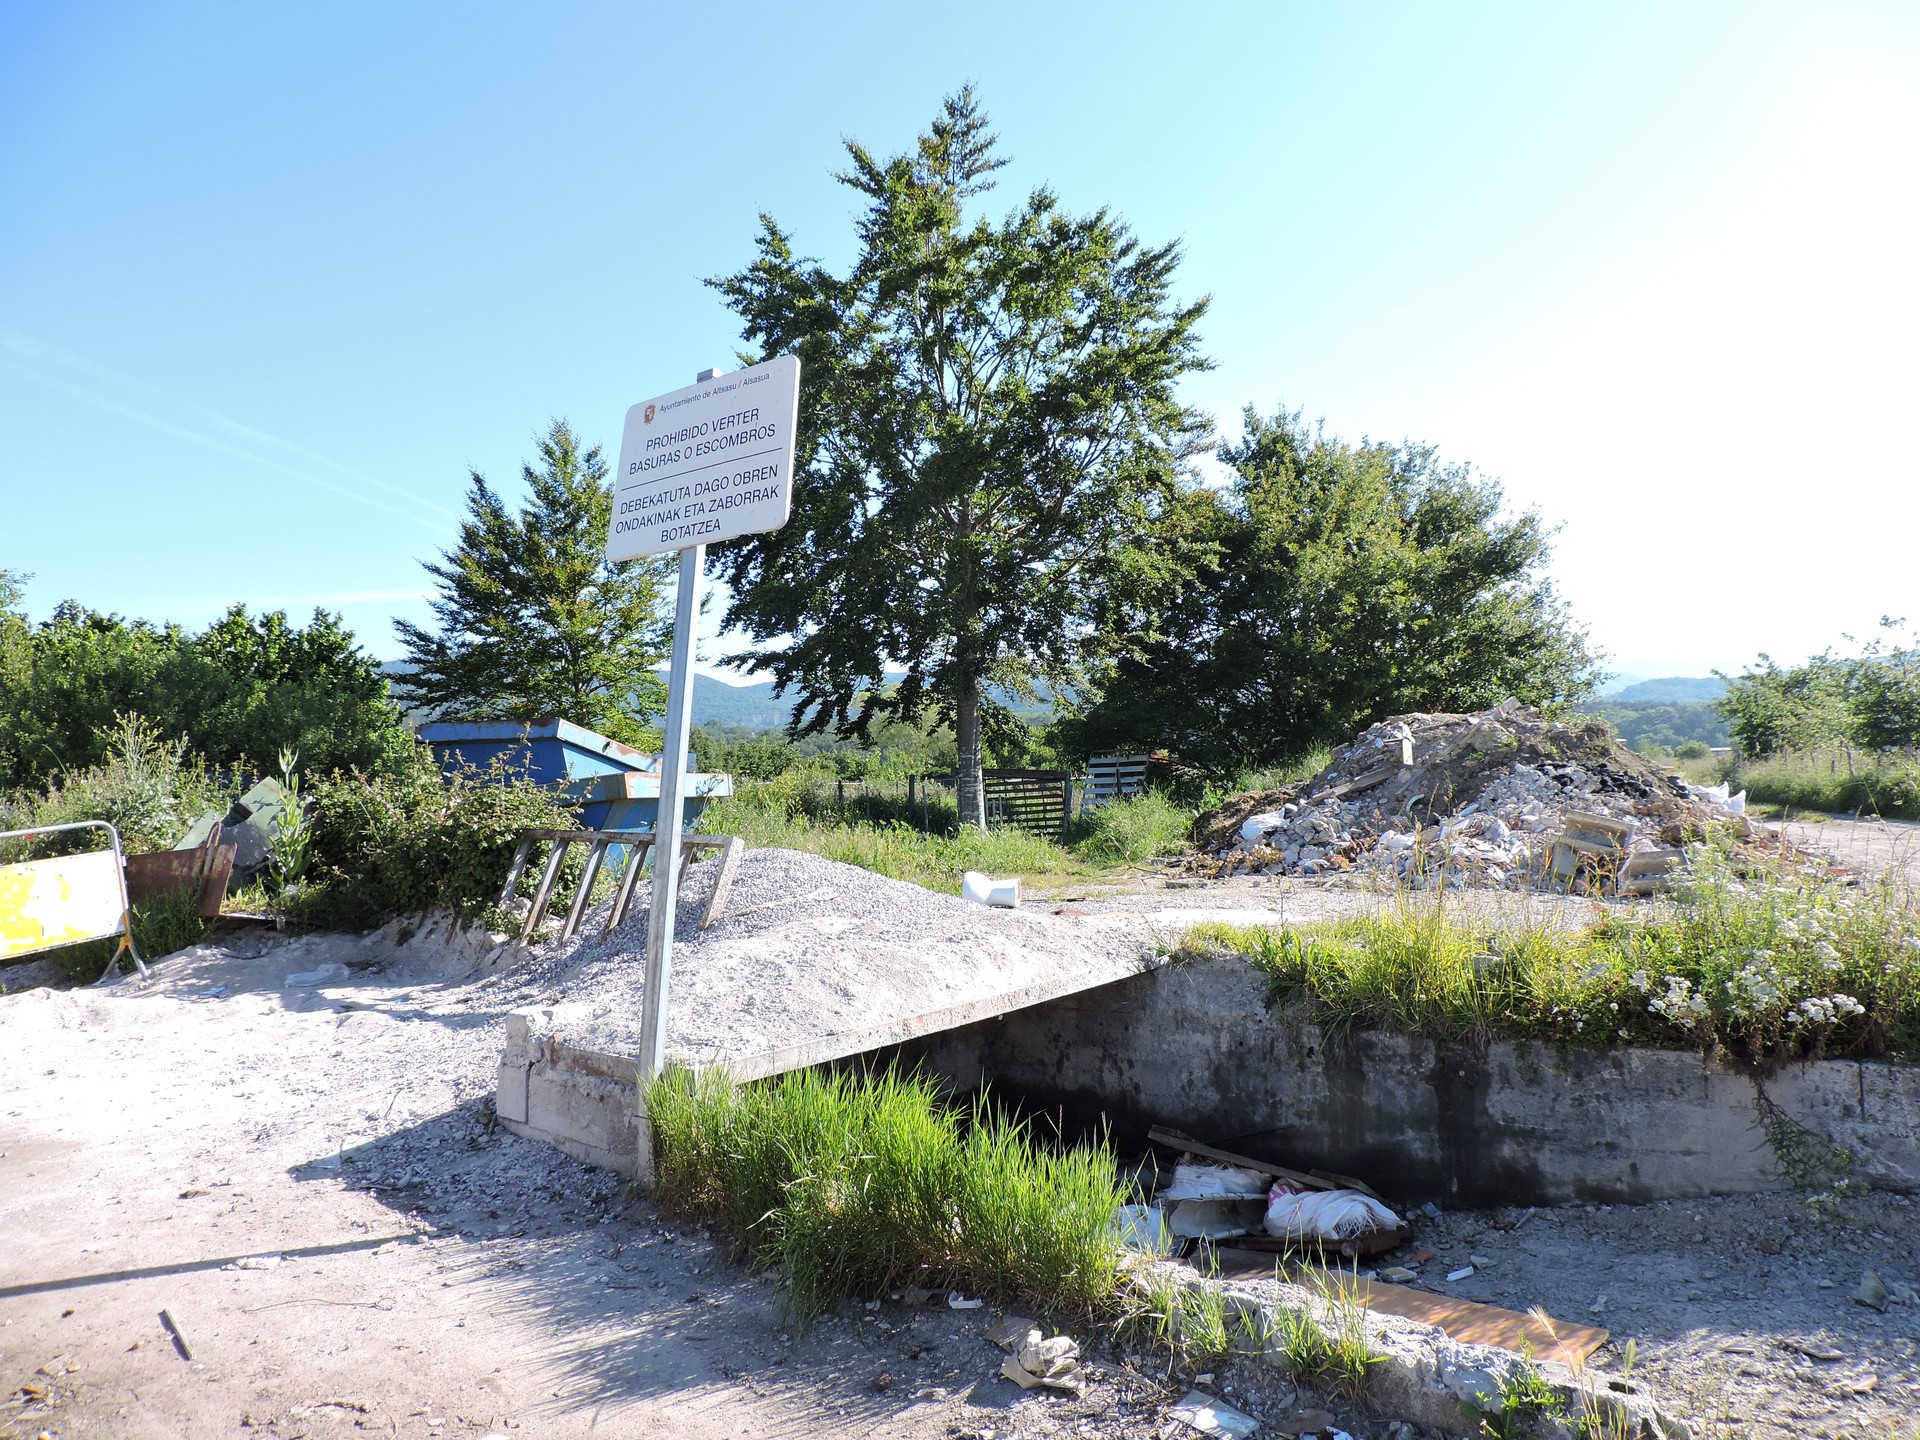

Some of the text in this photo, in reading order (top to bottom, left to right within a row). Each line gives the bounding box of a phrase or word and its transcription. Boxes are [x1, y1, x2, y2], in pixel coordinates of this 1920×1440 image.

[659, 372, 770, 413] Ayuntamiento de Altsasu / Alsasua
[629, 423, 776, 475] BASURAS O ESCOMBROS
[646, 408, 760, 452] PROHIBIDO VERTER
[615, 484, 780, 534] ONDAKINAK ETA ZABORRAK
[620, 464, 778, 515] DEBEKATUTA DAGO OBREN
[660, 518, 721, 543] BOTATZEA
